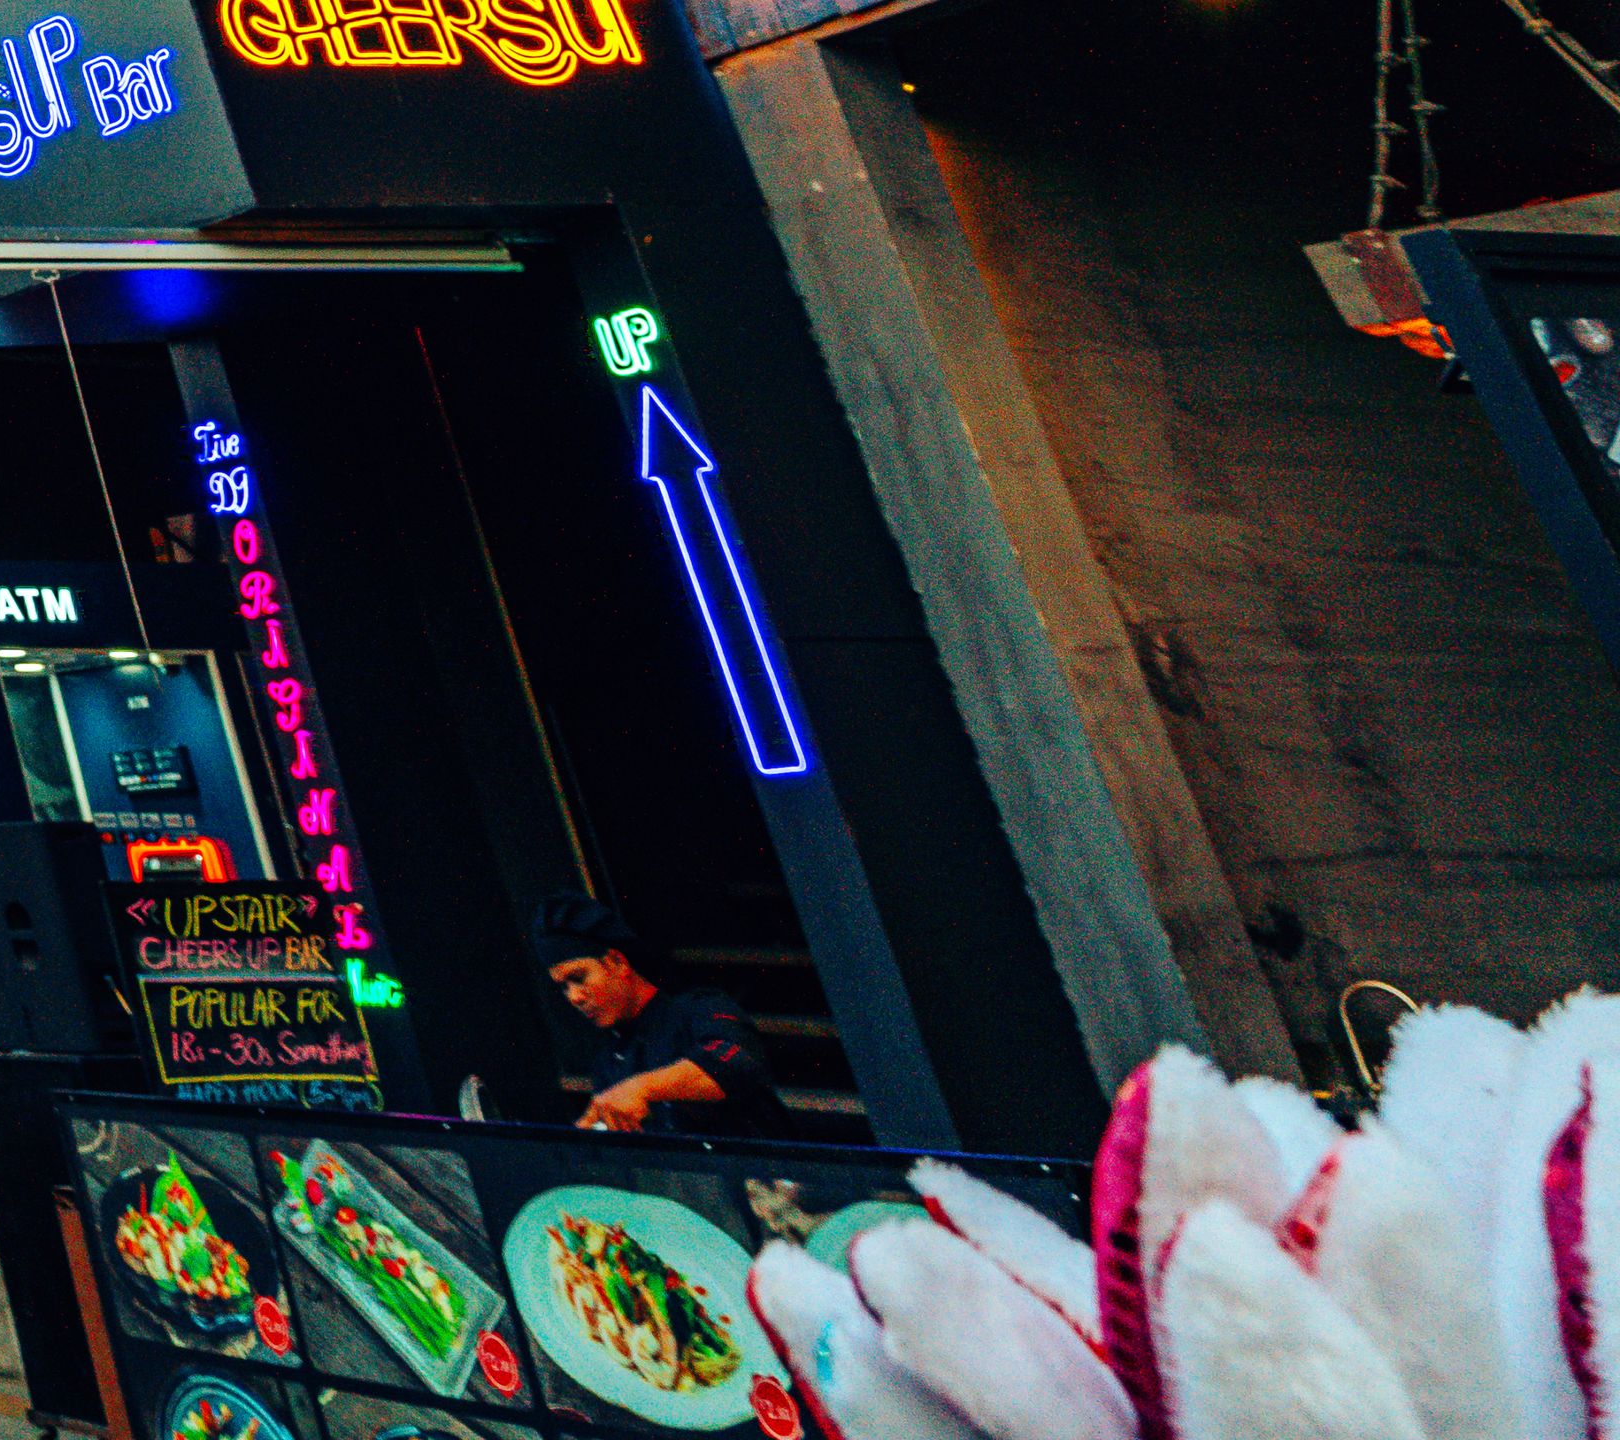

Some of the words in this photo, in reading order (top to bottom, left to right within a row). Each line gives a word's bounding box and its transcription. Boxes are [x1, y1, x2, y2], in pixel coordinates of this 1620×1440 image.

[81, 46, 173, 137] Bar
[593, 307, 658, 376] UP
[285, 935, 334, 971] BAR
[170, 986, 292, 1028] POPULAR
[297, 988, 347, 1024] FOR
